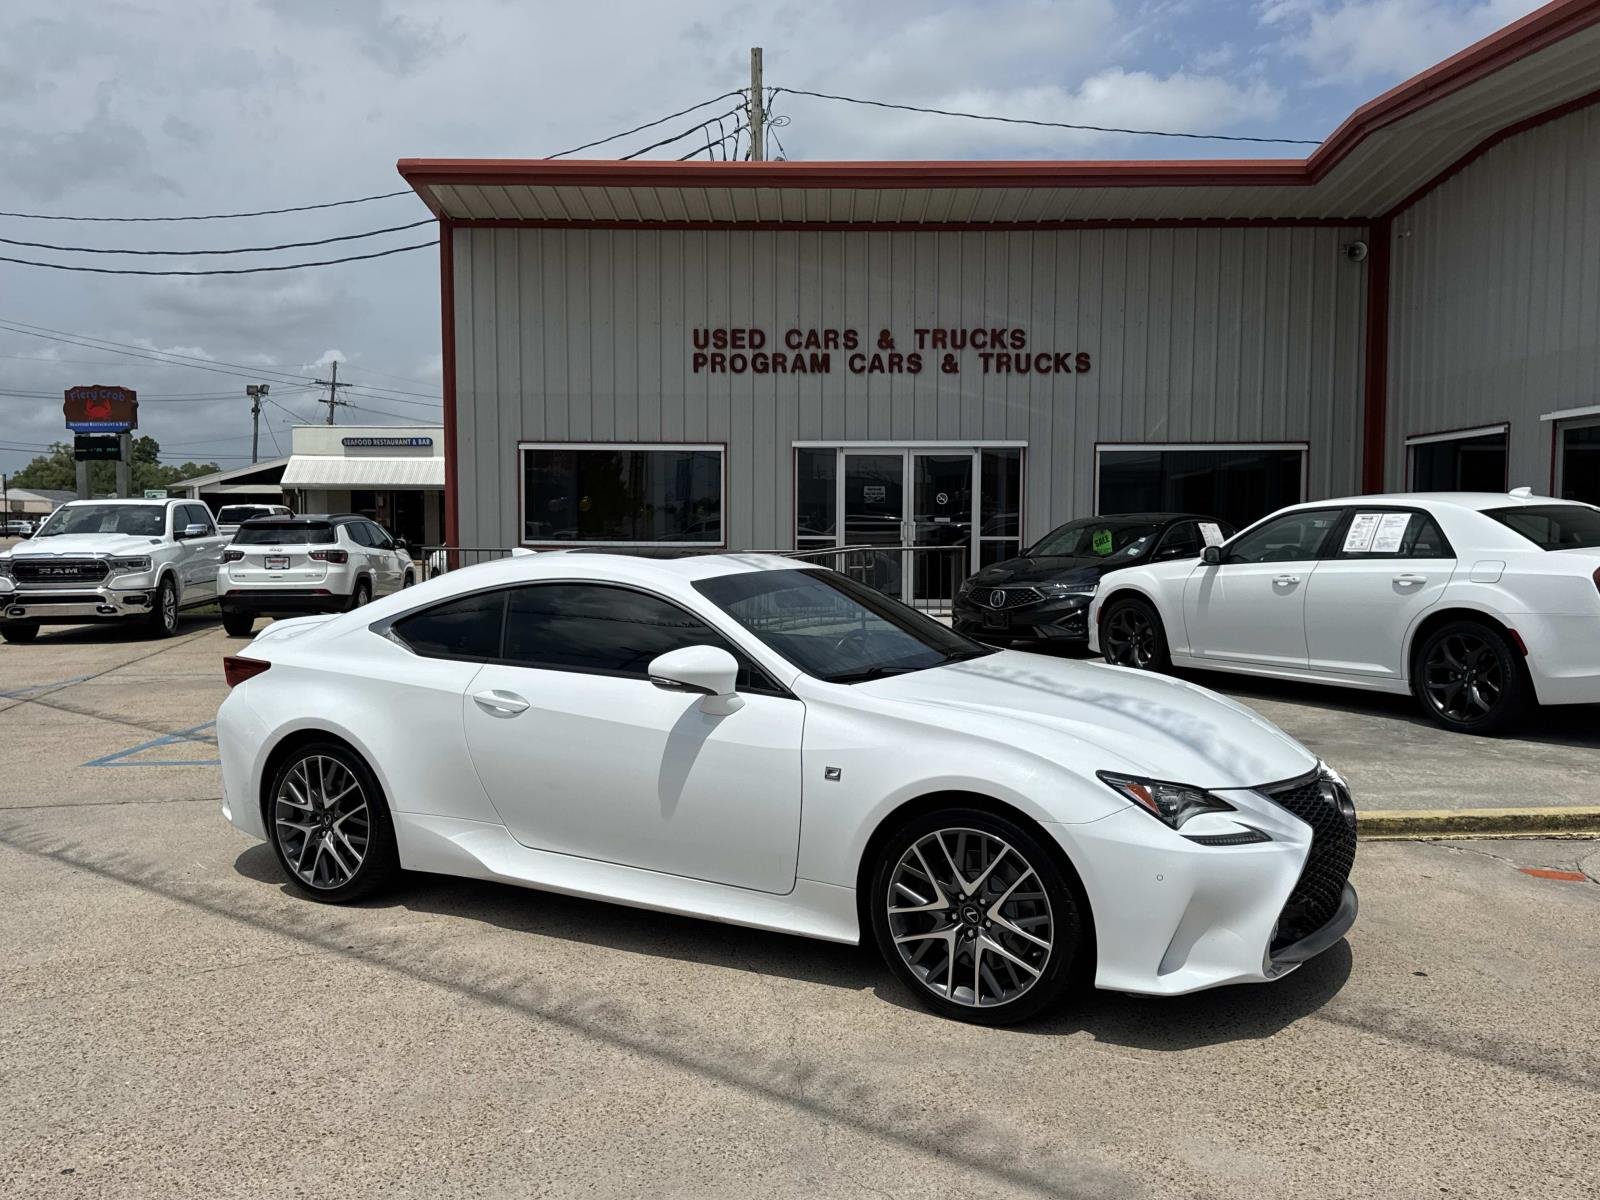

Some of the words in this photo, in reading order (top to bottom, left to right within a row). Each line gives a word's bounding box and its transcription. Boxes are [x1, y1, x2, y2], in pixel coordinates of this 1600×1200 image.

[693, 328, 766, 350] USED
[785, 328, 858, 350] CARS
[877, 328, 895, 351] &
[913, 328, 1026, 350] TRUCKS
[693, 352, 831, 374] PROGRAM
[848, 352, 922, 374] CARS
[941, 353, 959, 374] &
[978, 352, 1091, 374] TRUCKS
